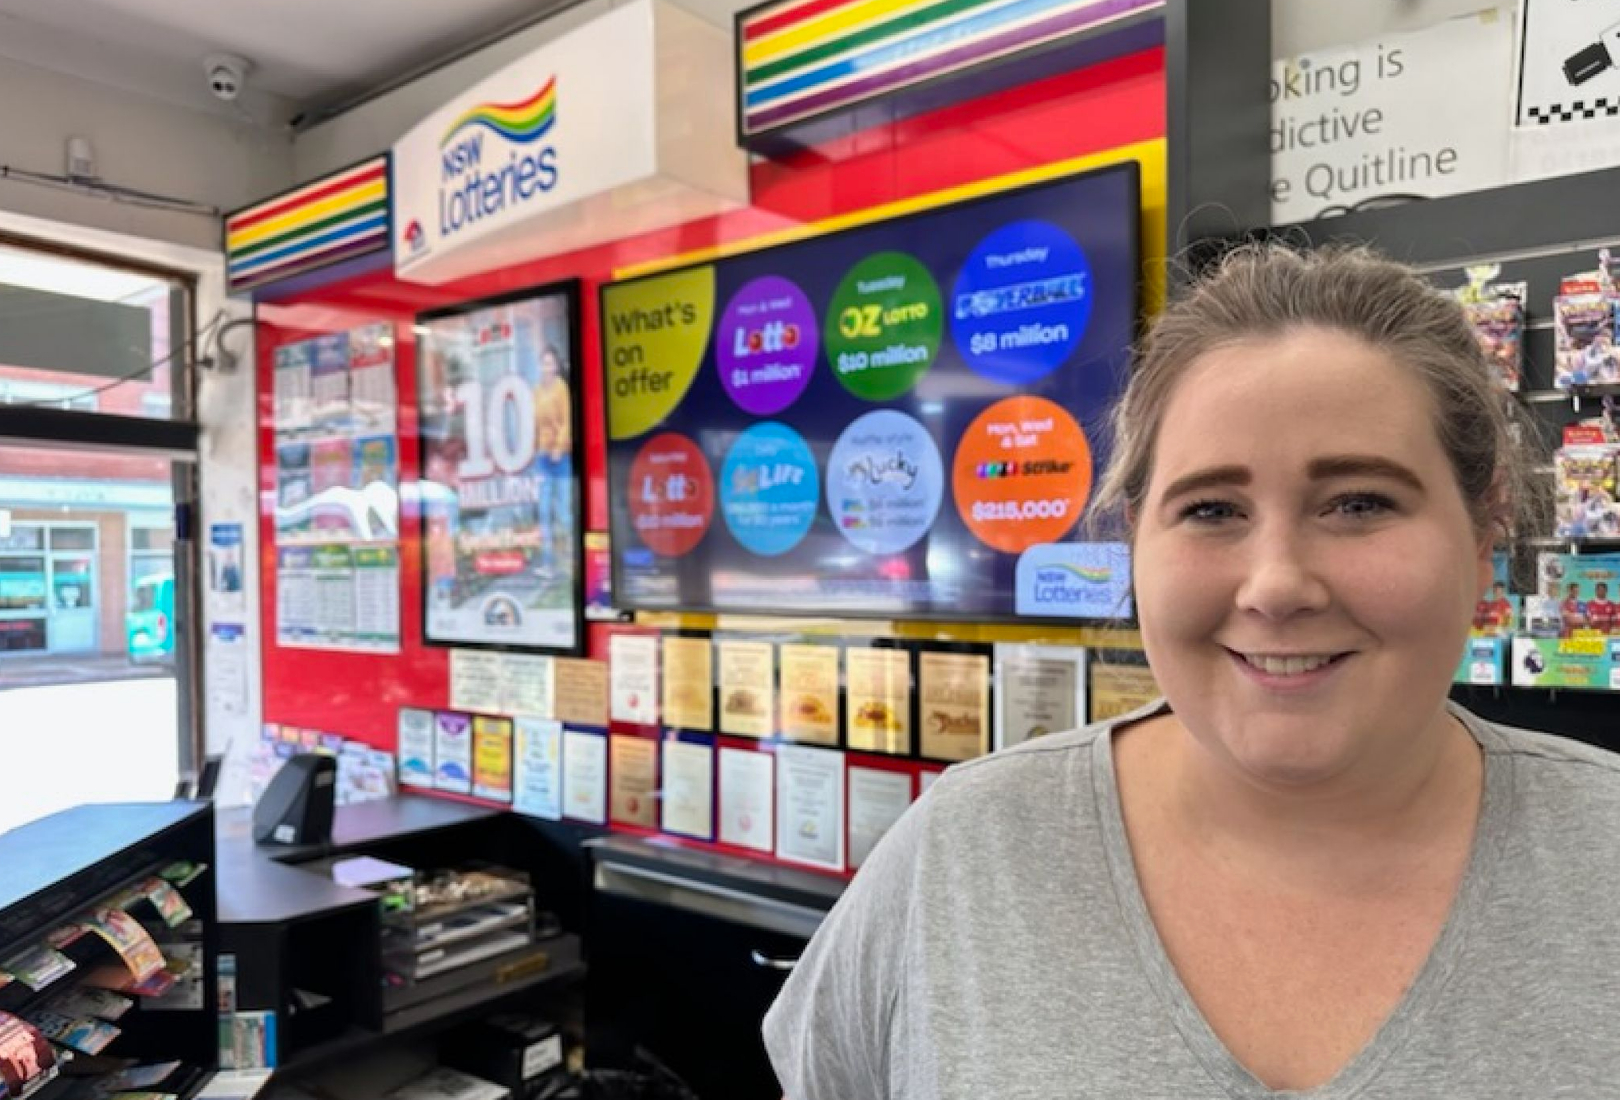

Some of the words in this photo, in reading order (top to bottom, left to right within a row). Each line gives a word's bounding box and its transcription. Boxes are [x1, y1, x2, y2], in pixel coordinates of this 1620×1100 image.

[1377, 44, 1404, 79] is
[442, 131, 483, 180] NSW
[1304, 146, 1458, 200] Quitline
[439, 146, 558, 237] Lotteries
[986, 247, 1049, 268] Thursday
[611, 302, 697, 336] What's
[839, 304, 883, 339] OZ
[883, 302, 929, 326] LOTTO
[614, 344, 644, 367] on
[733, 321, 800, 358] Lotto
[869, 343, 929, 368] million
[970, 332, 997, 355] $8
[1000, 323, 1070, 350] million
[614, 368, 675, 398] offer
